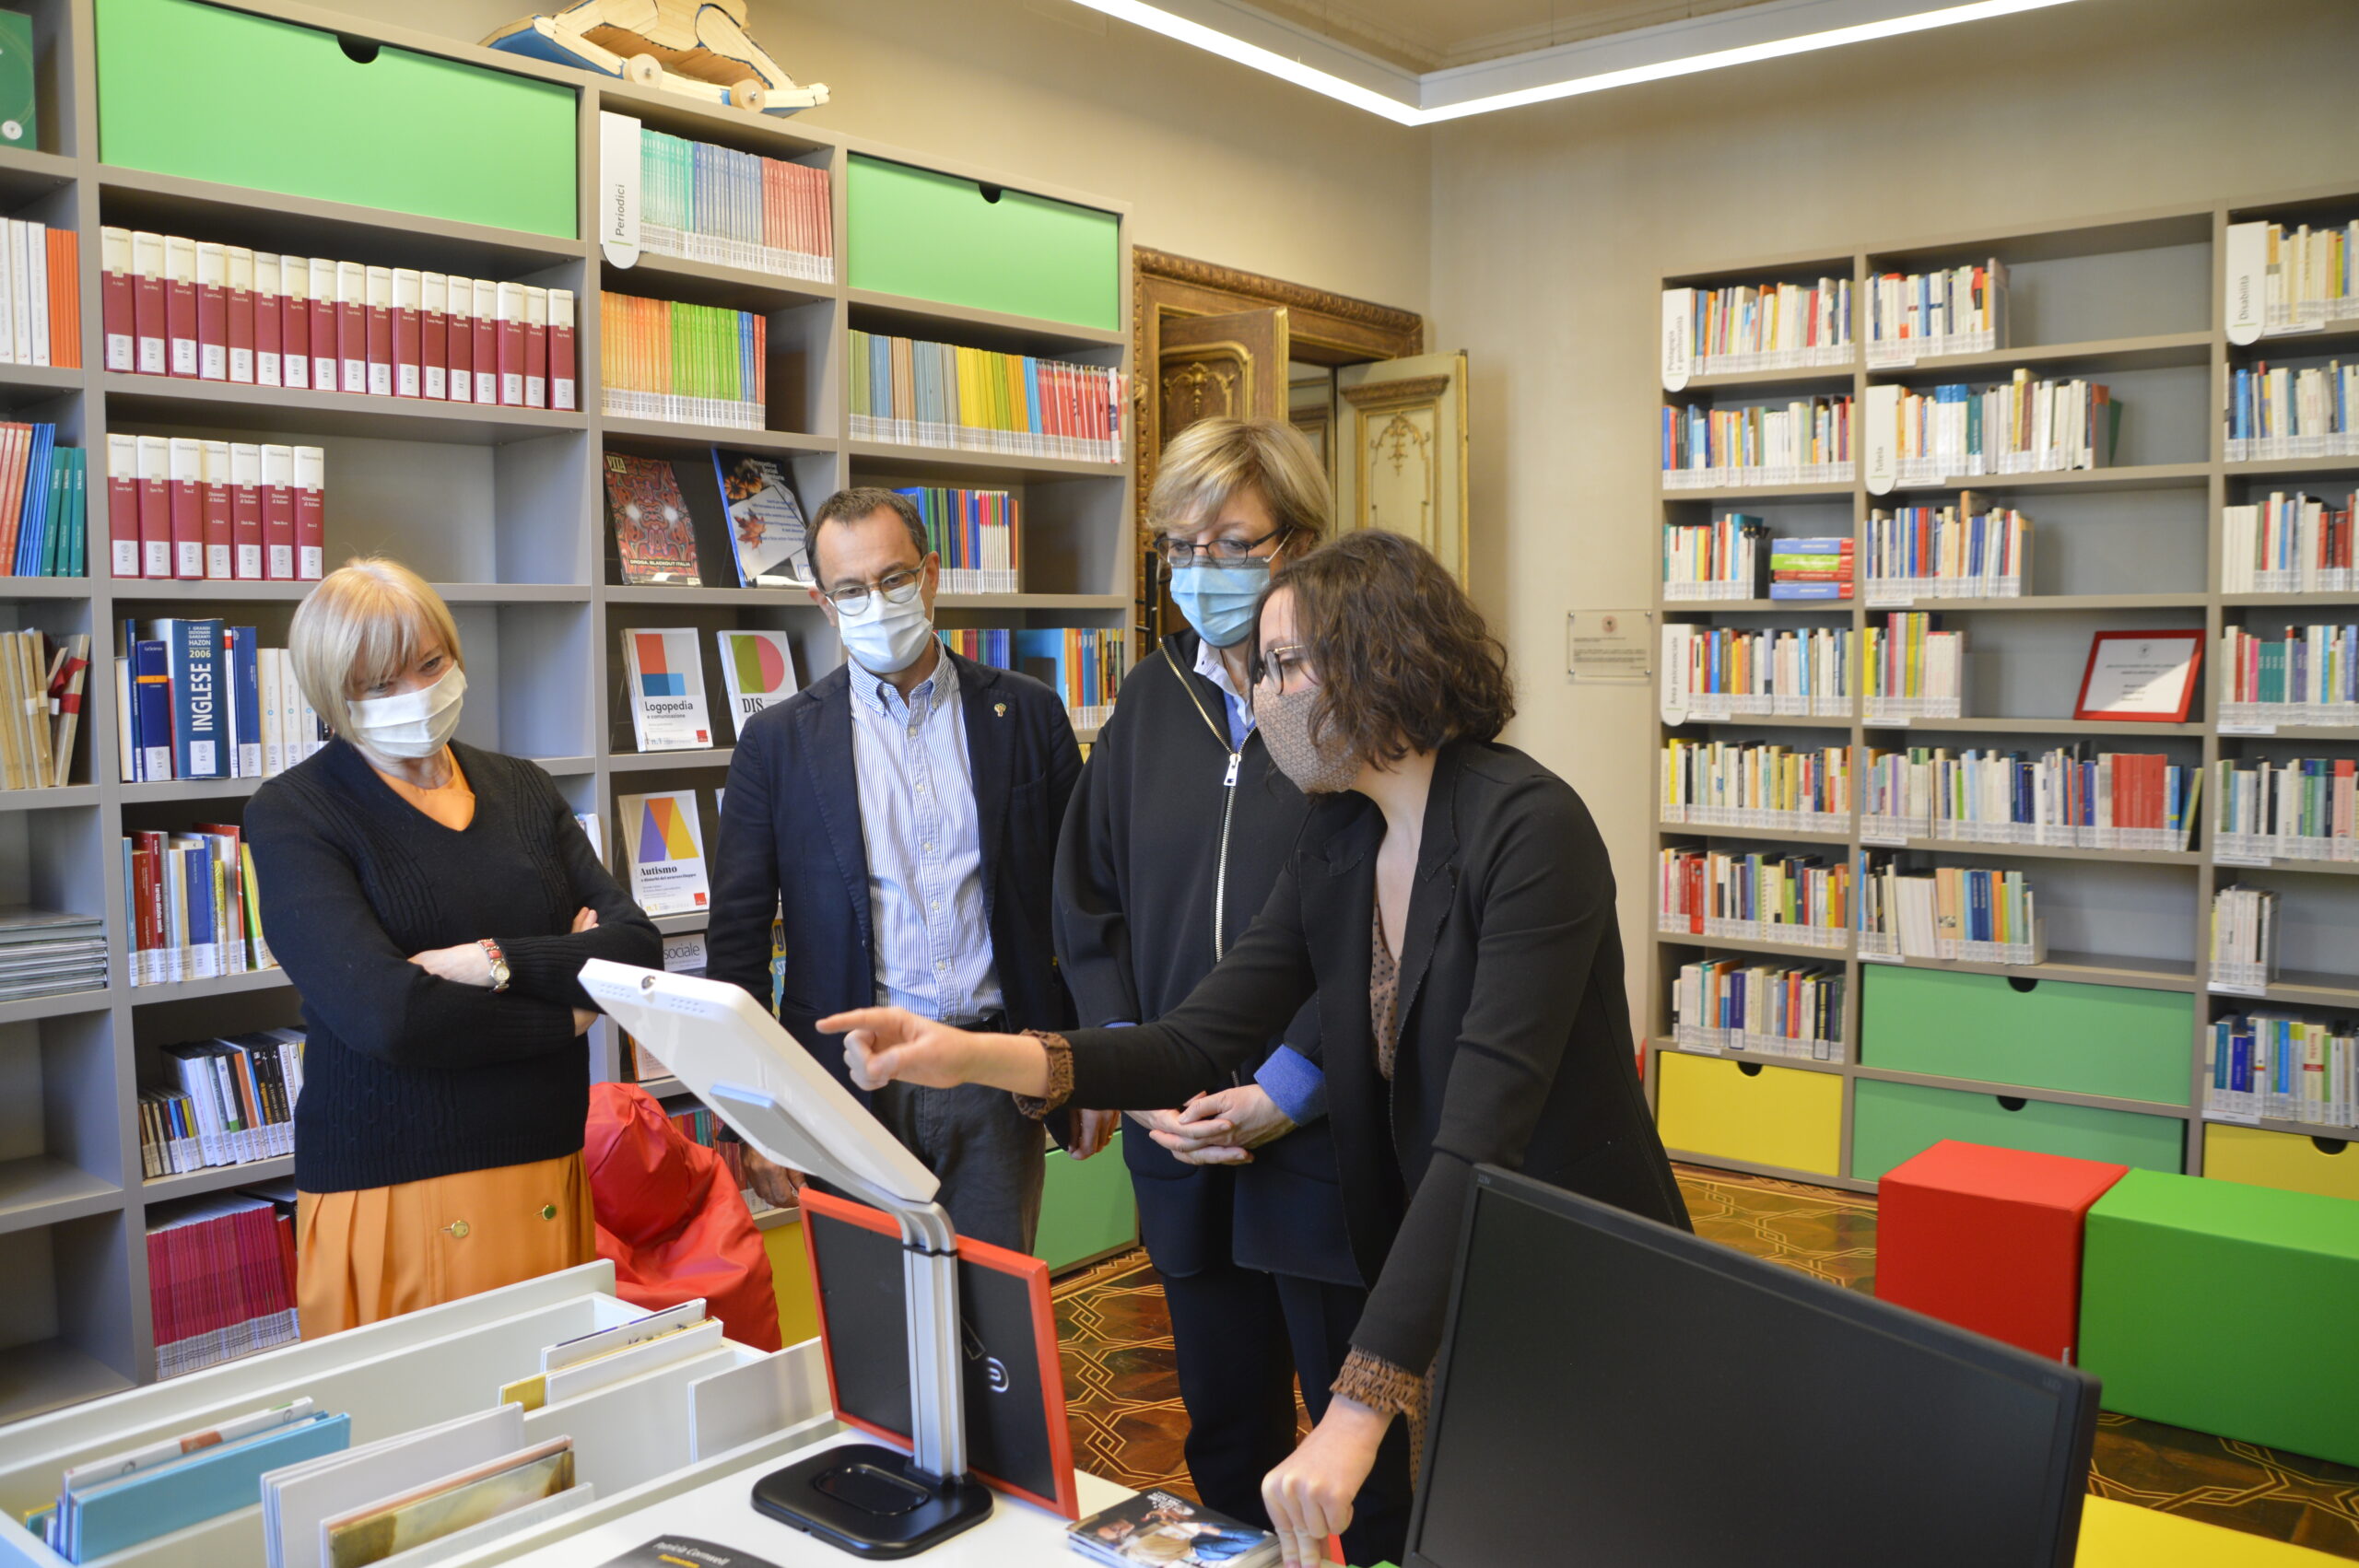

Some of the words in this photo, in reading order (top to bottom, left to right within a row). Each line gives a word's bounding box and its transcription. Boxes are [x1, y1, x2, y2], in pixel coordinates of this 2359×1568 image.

[615, 183, 625, 237] Periodici
[2238, 275, 2249, 321] Disabilità
[1666, 330, 1676, 371] Pedagogia
[1675, 315, 1685, 363] genitorialità
[606, 455, 626, 471] VITA
[1874, 446, 1884, 473] Tutela
[1671, 637, 1679, 685] psicosociale
[190, 663, 213, 731] INGLESE
[644, 700, 694, 714] Logopedia
[742, 697, 764, 713] DIS
[640, 866, 677, 876] Autismo
[663, 941, 700, 960] sociale
[686, 1547, 731, 1566] Cornwell
